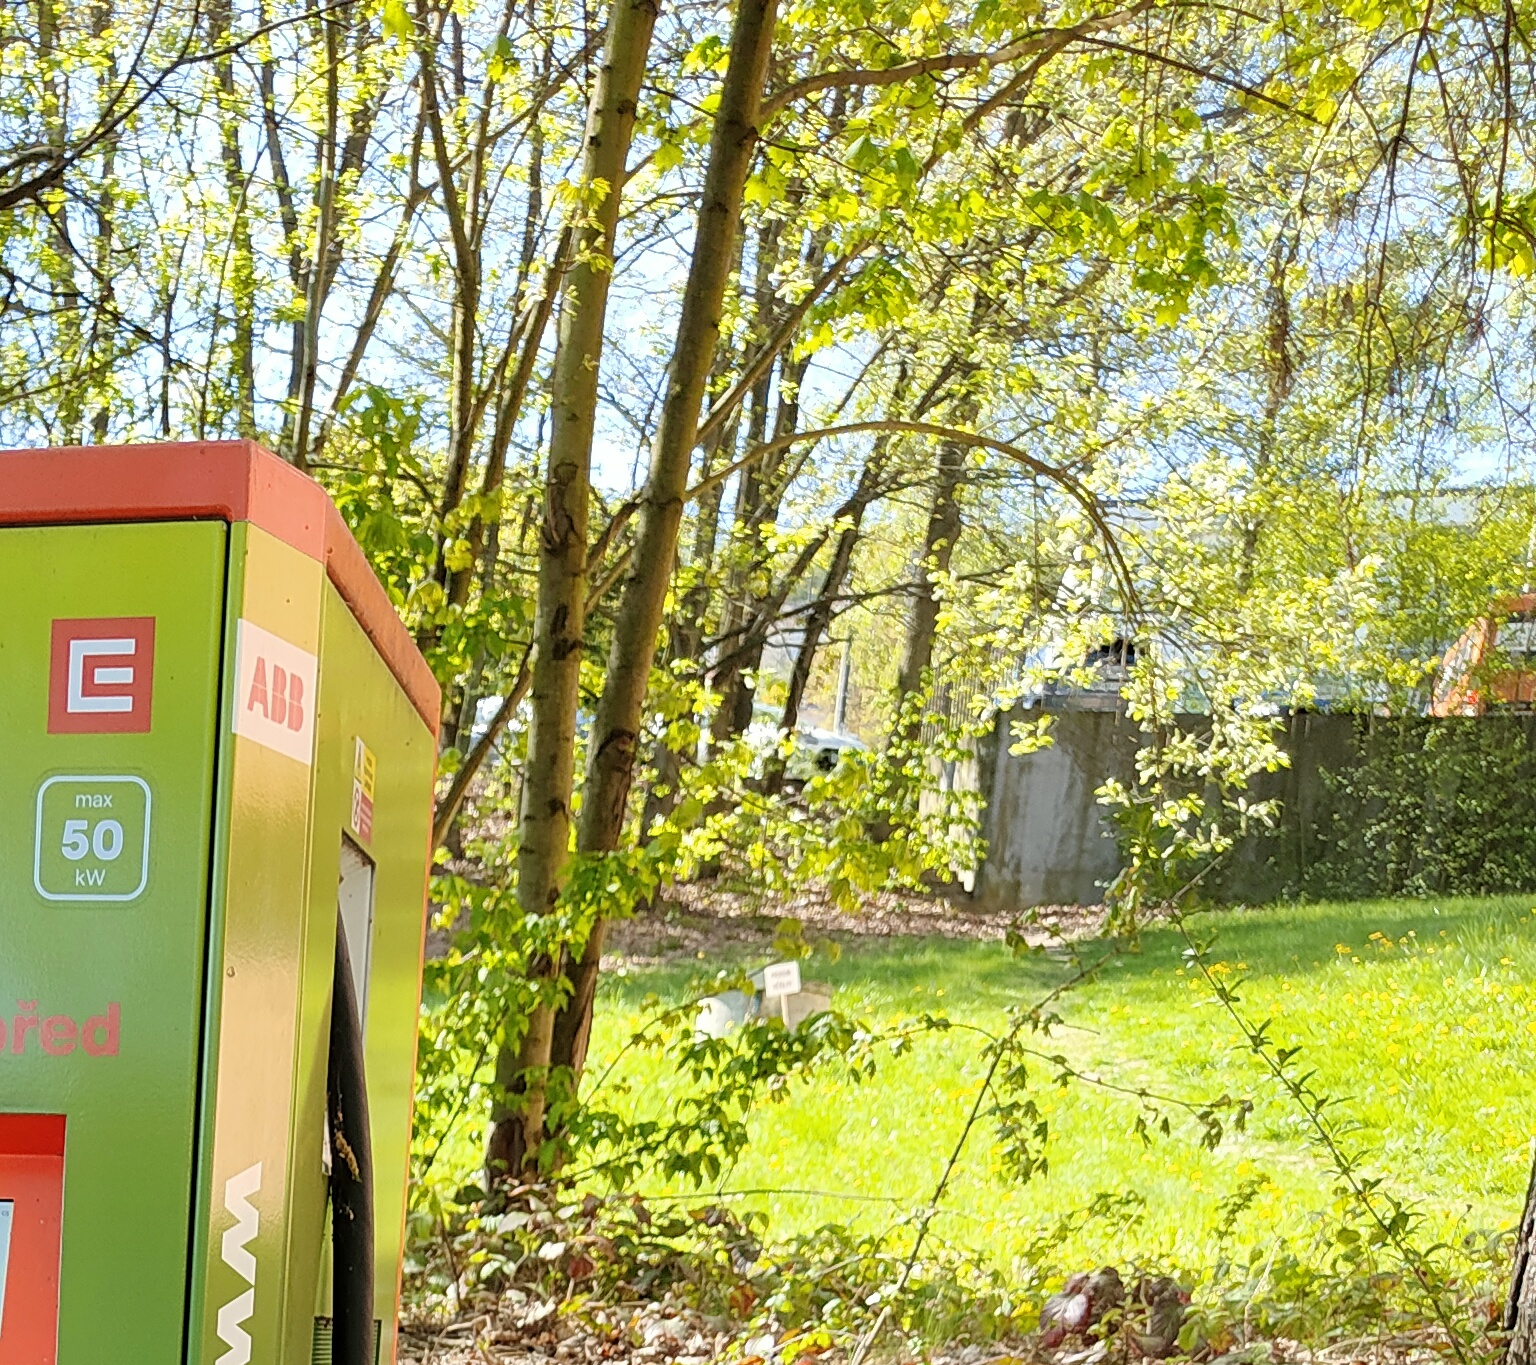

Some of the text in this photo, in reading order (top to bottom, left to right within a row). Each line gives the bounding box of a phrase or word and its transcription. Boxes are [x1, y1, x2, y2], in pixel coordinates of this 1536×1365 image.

[247, 656, 304, 732] ABB
[75, 794, 113, 809] max
[61, 819, 124, 861] 50
[75, 869, 106, 887] kW
